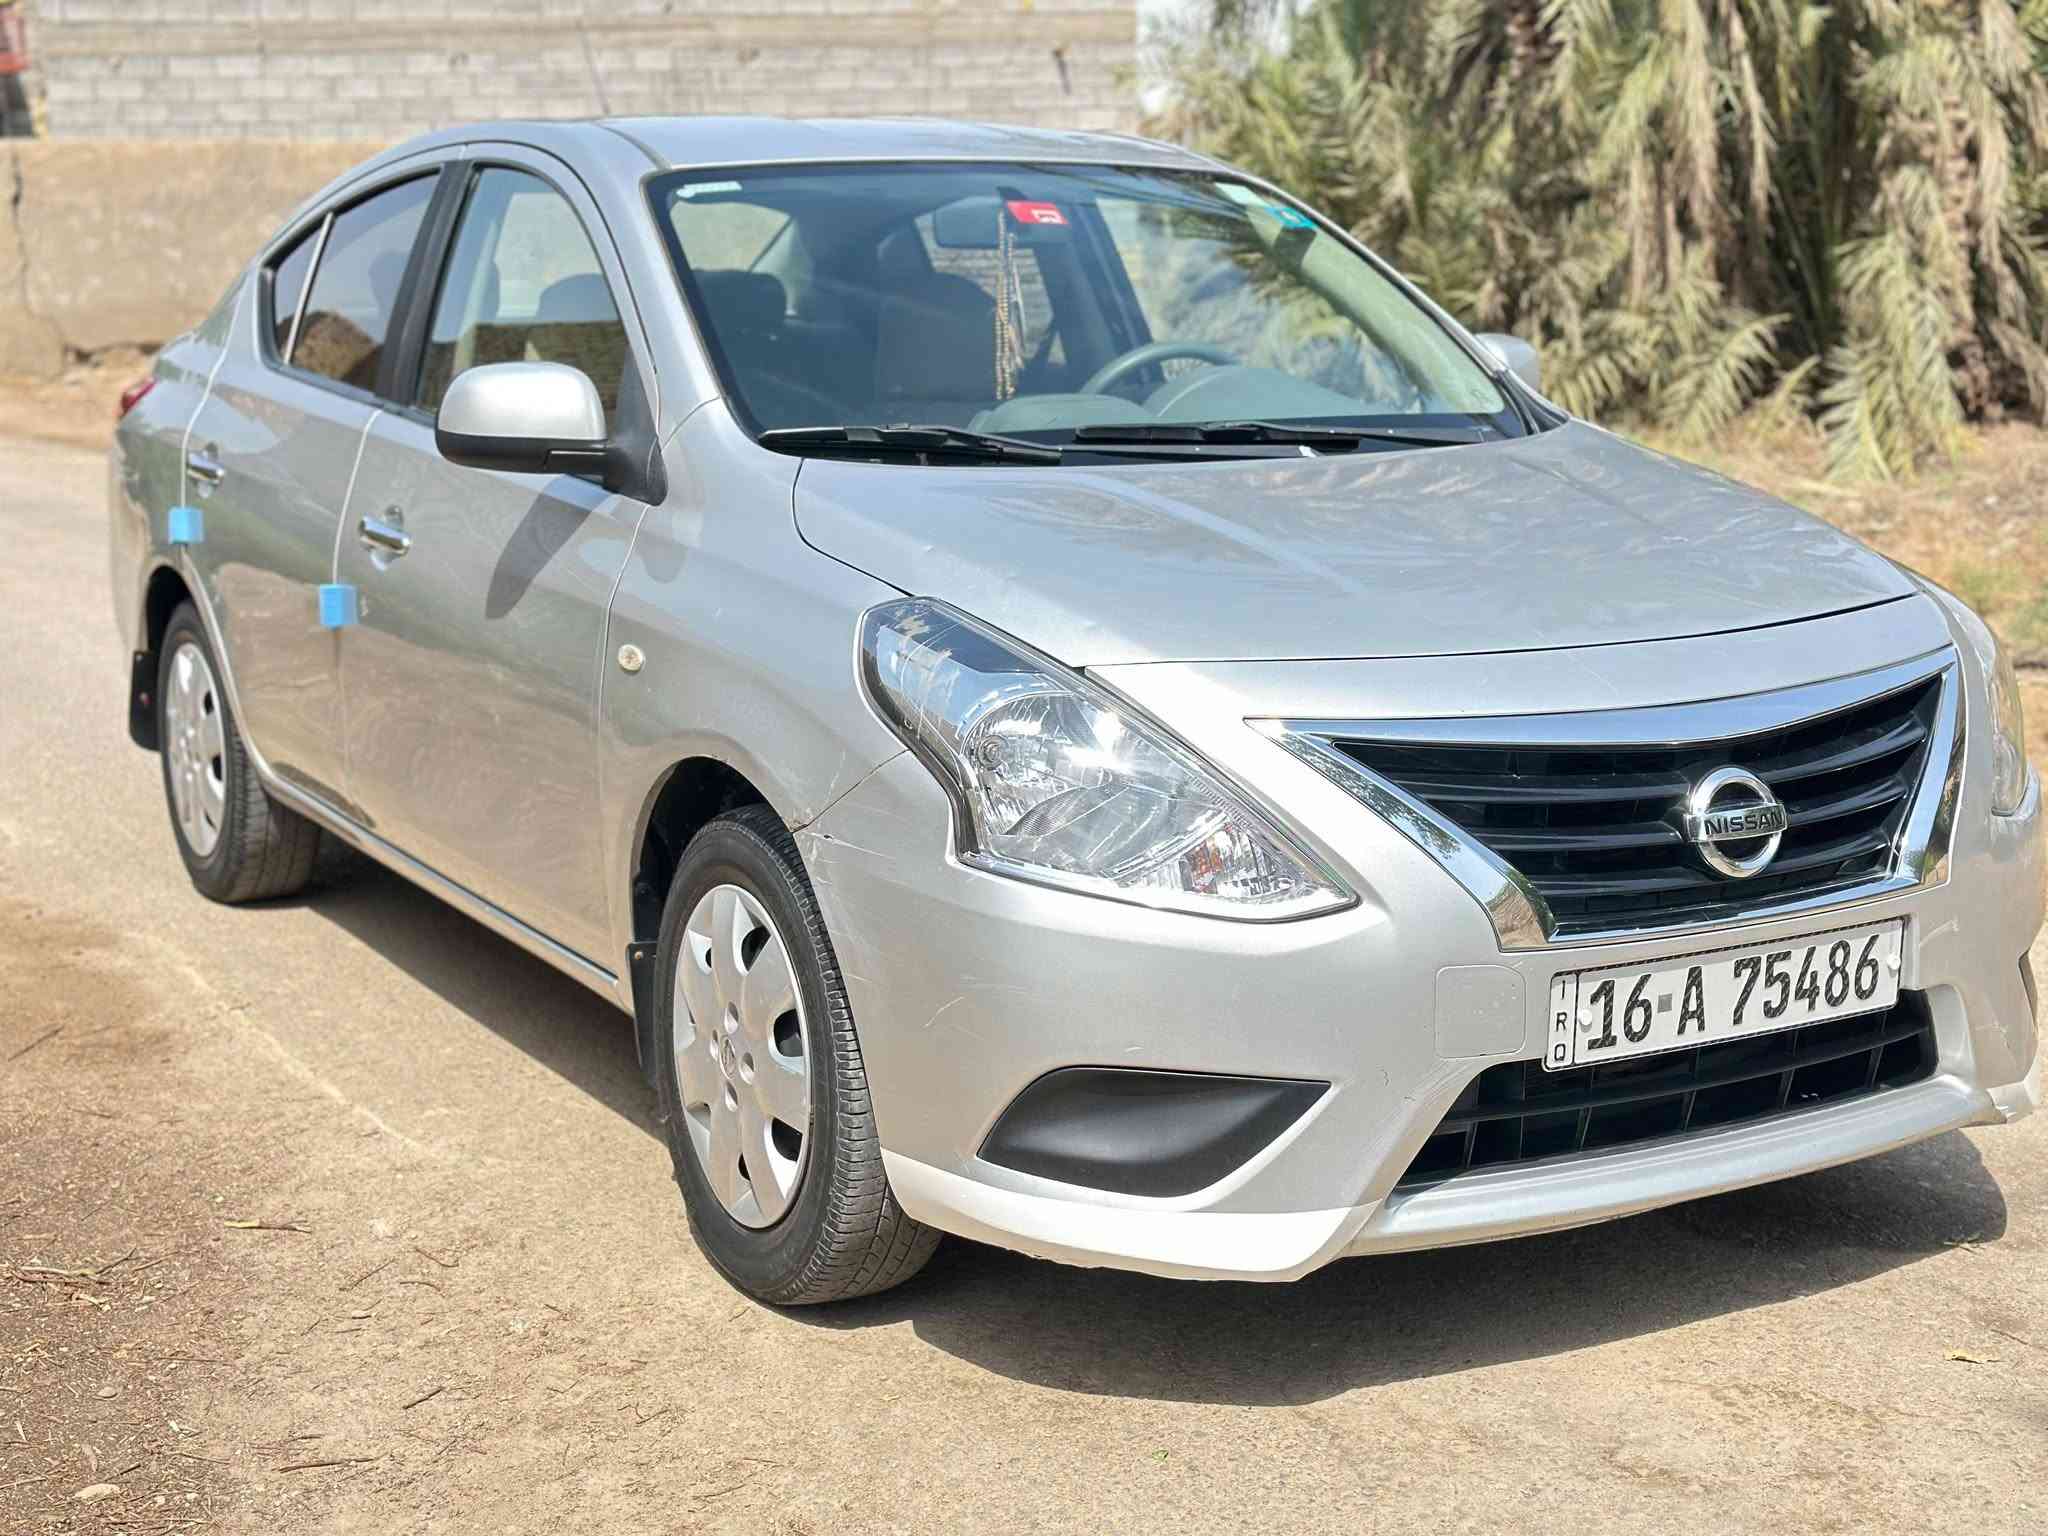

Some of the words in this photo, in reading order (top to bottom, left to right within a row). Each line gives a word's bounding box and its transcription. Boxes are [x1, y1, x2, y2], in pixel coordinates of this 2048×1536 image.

[1704, 810, 1784, 835] NISSAN
[1553, 979, 1568, 1062] IRQ
[1588, 973, 1652, 1051] 16
[1677, 965, 1706, 1036] A
[1732, 934, 1879, 1026] 75486
